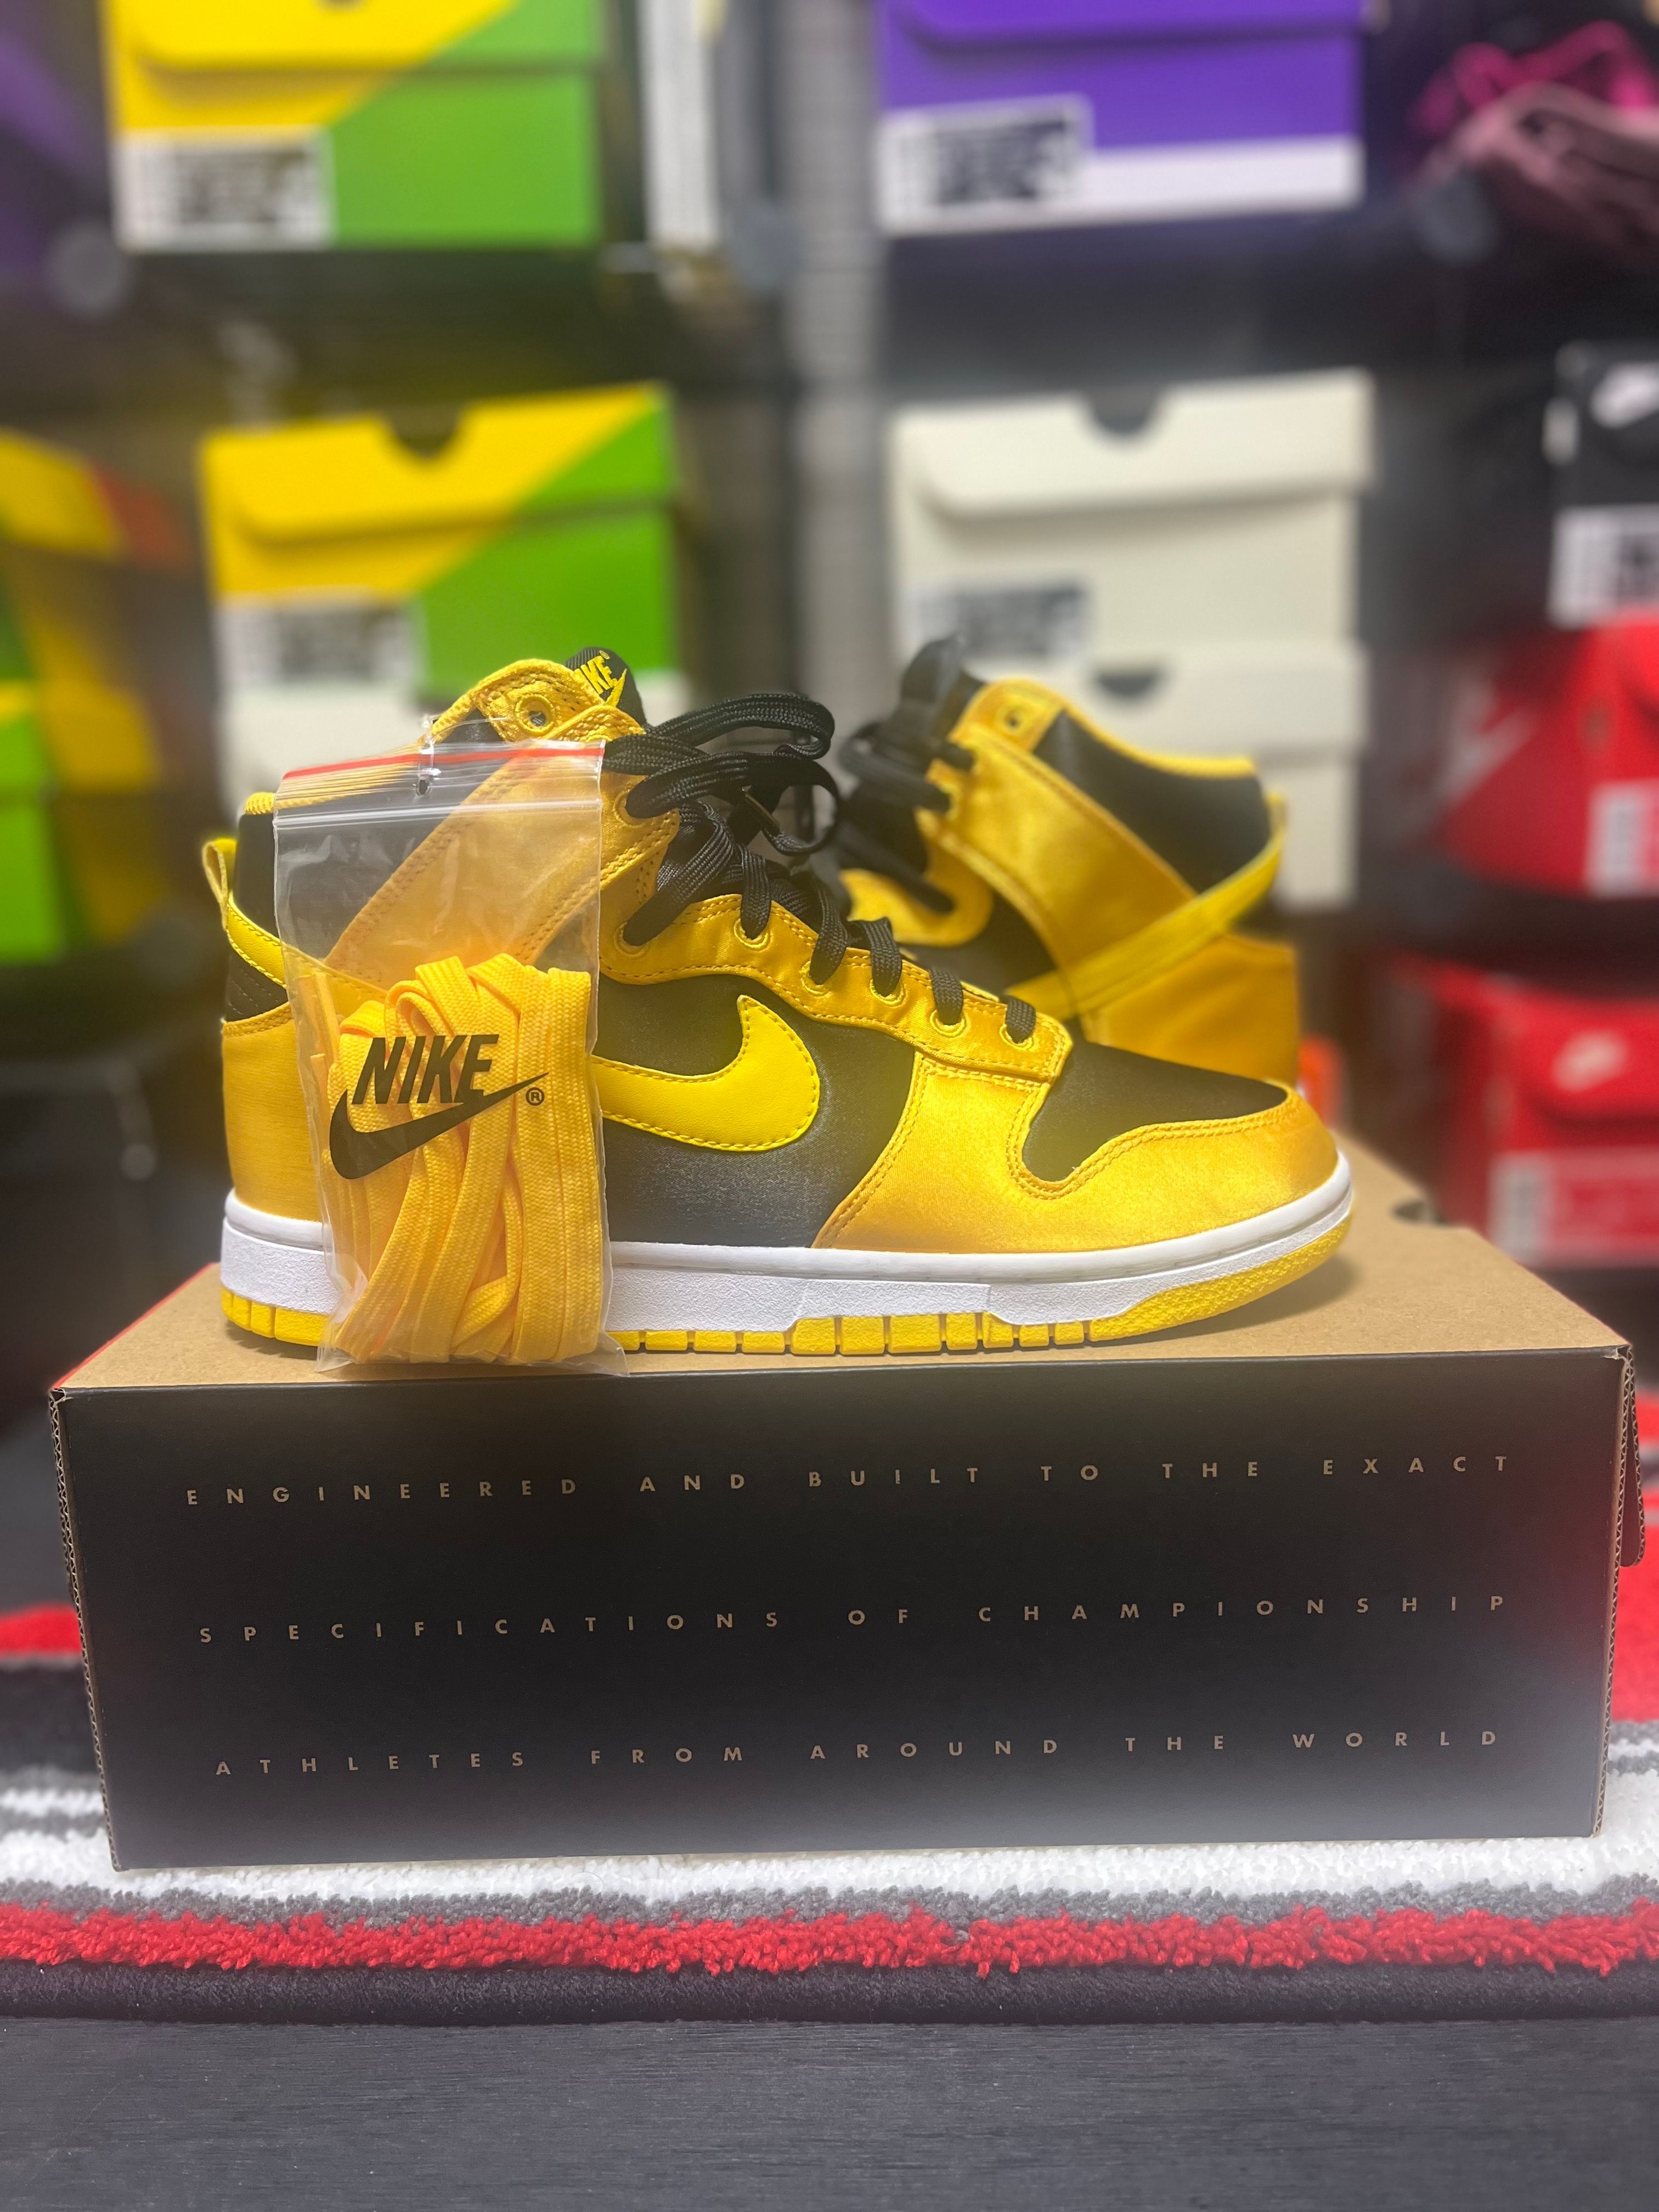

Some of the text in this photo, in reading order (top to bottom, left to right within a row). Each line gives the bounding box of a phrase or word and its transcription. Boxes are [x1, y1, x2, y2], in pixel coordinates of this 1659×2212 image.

[352, 1034, 500, 1105] NIKE
[187, 1456, 1506, 1505] ENGINEERED AND BUILT TO THE EXACT
[200, 1595, 1503, 1643] SPECIFICATIONS OF CHAMPIONSHIP
[216, 1731, 1496, 1775] ATHLETES FROM AROUND THE WORLD
